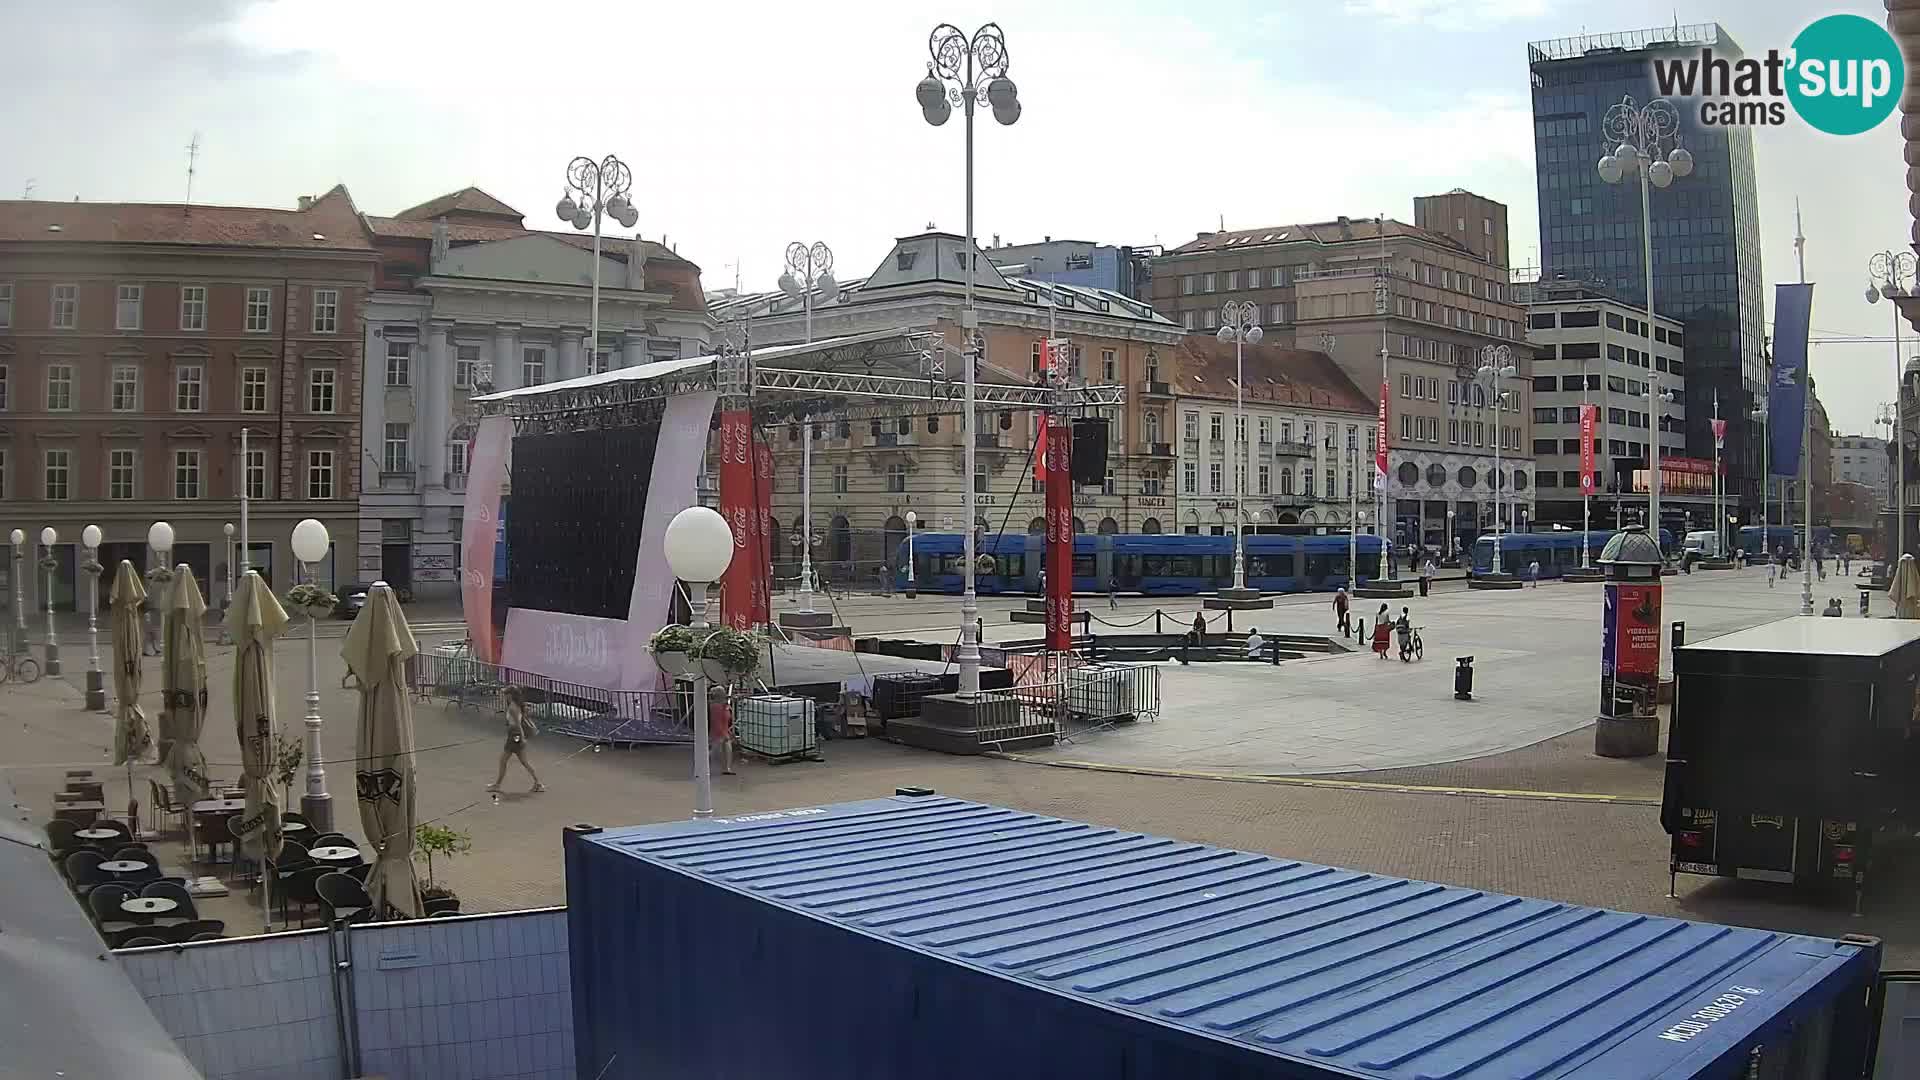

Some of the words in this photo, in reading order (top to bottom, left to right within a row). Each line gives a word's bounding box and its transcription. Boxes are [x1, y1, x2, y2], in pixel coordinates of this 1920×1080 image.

[960, 495, 996, 505] SGER
[1657, 1019, 1709, 1043] MCDU
[1691, 993, 1748, 1022] 300629
